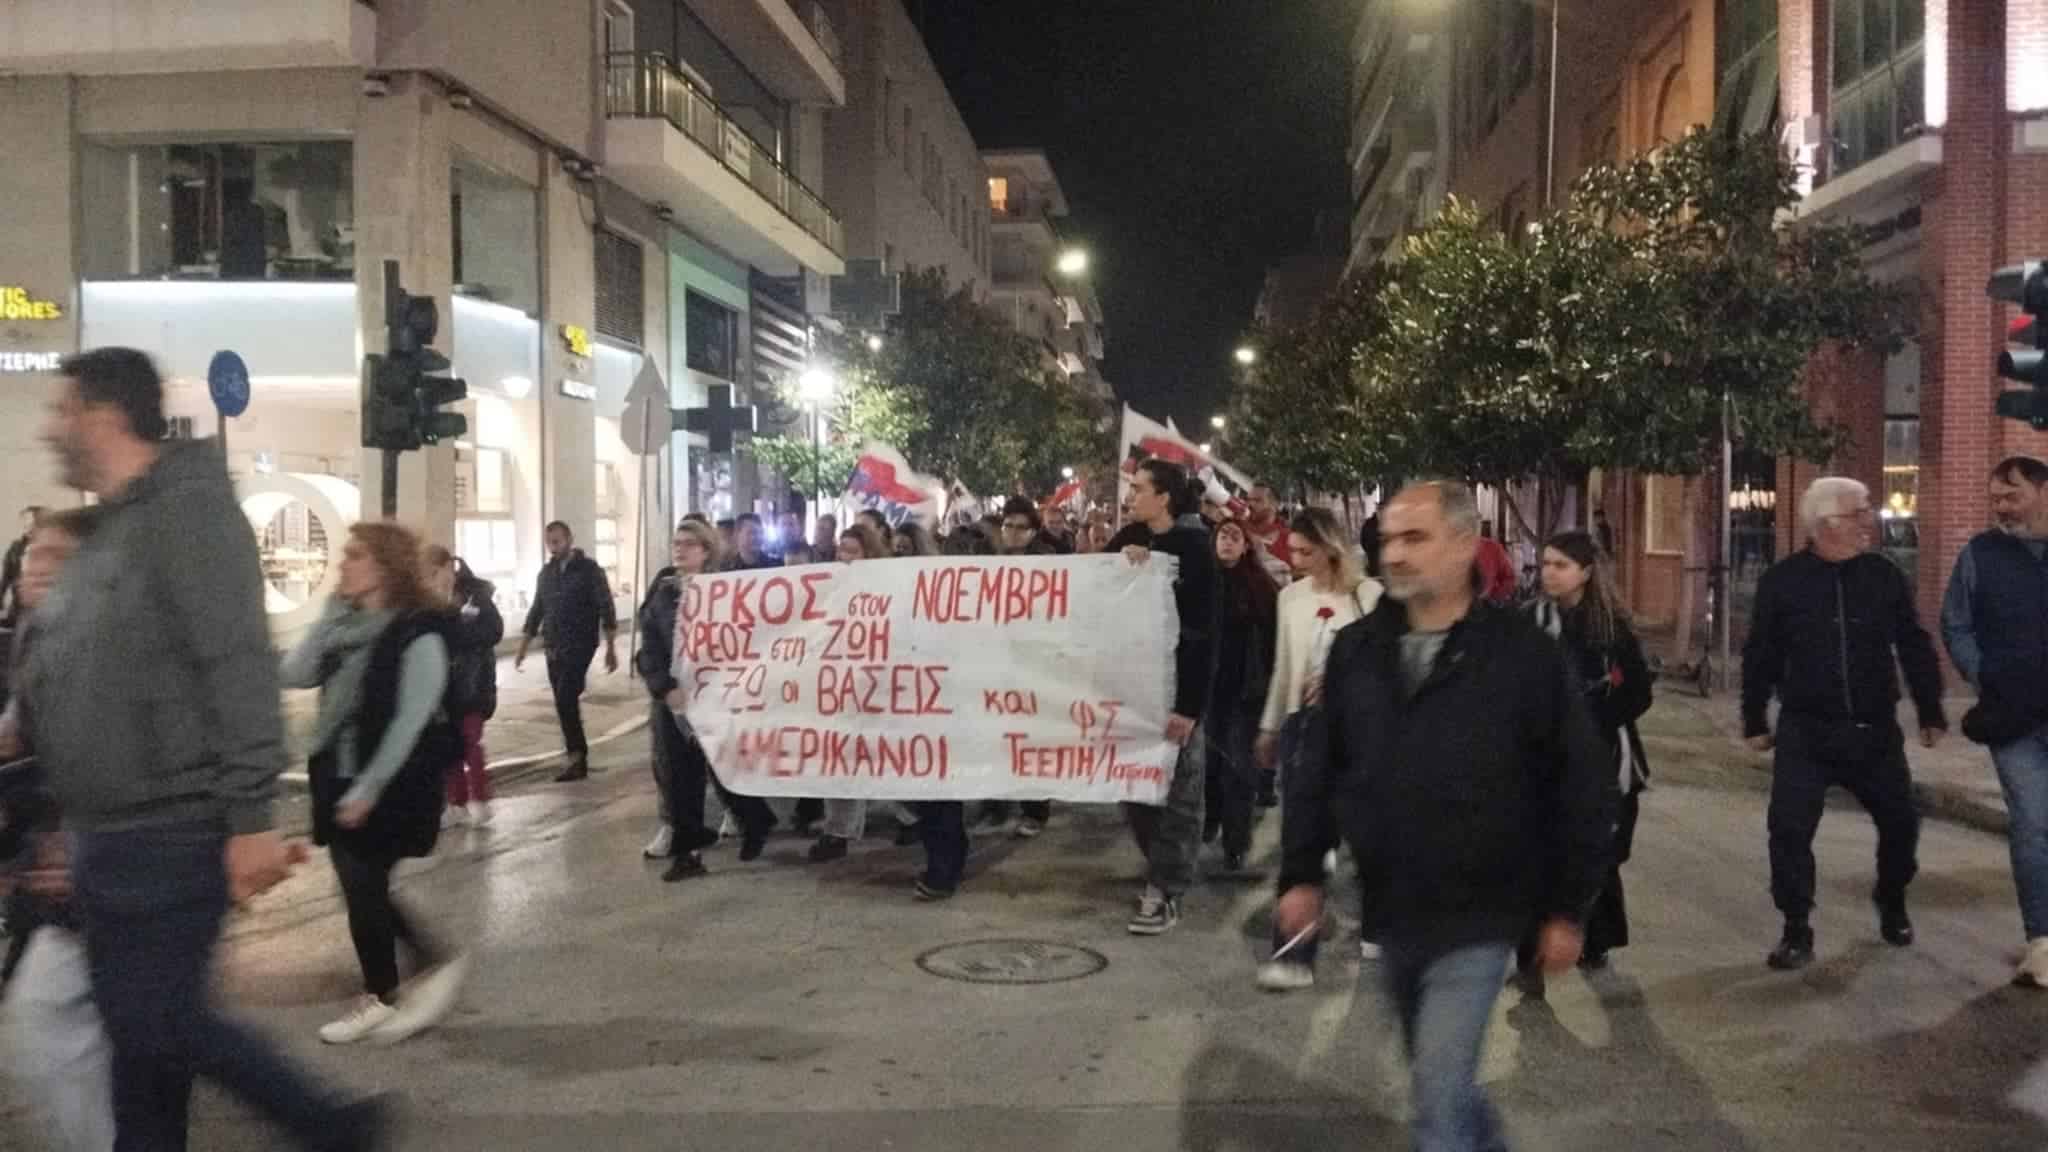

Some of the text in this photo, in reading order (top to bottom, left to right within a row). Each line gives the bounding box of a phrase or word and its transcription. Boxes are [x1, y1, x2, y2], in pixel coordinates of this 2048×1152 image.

[912, 566, 1069, 625] ΝΟΕΜΒΡΗ
[678, 621, 761, 662] ΧΡΕΟΣ
[820, 619, 890, 661] ΖΩΗ
[817, 665, 954, 716] ΒΑΣΕΙΣ
